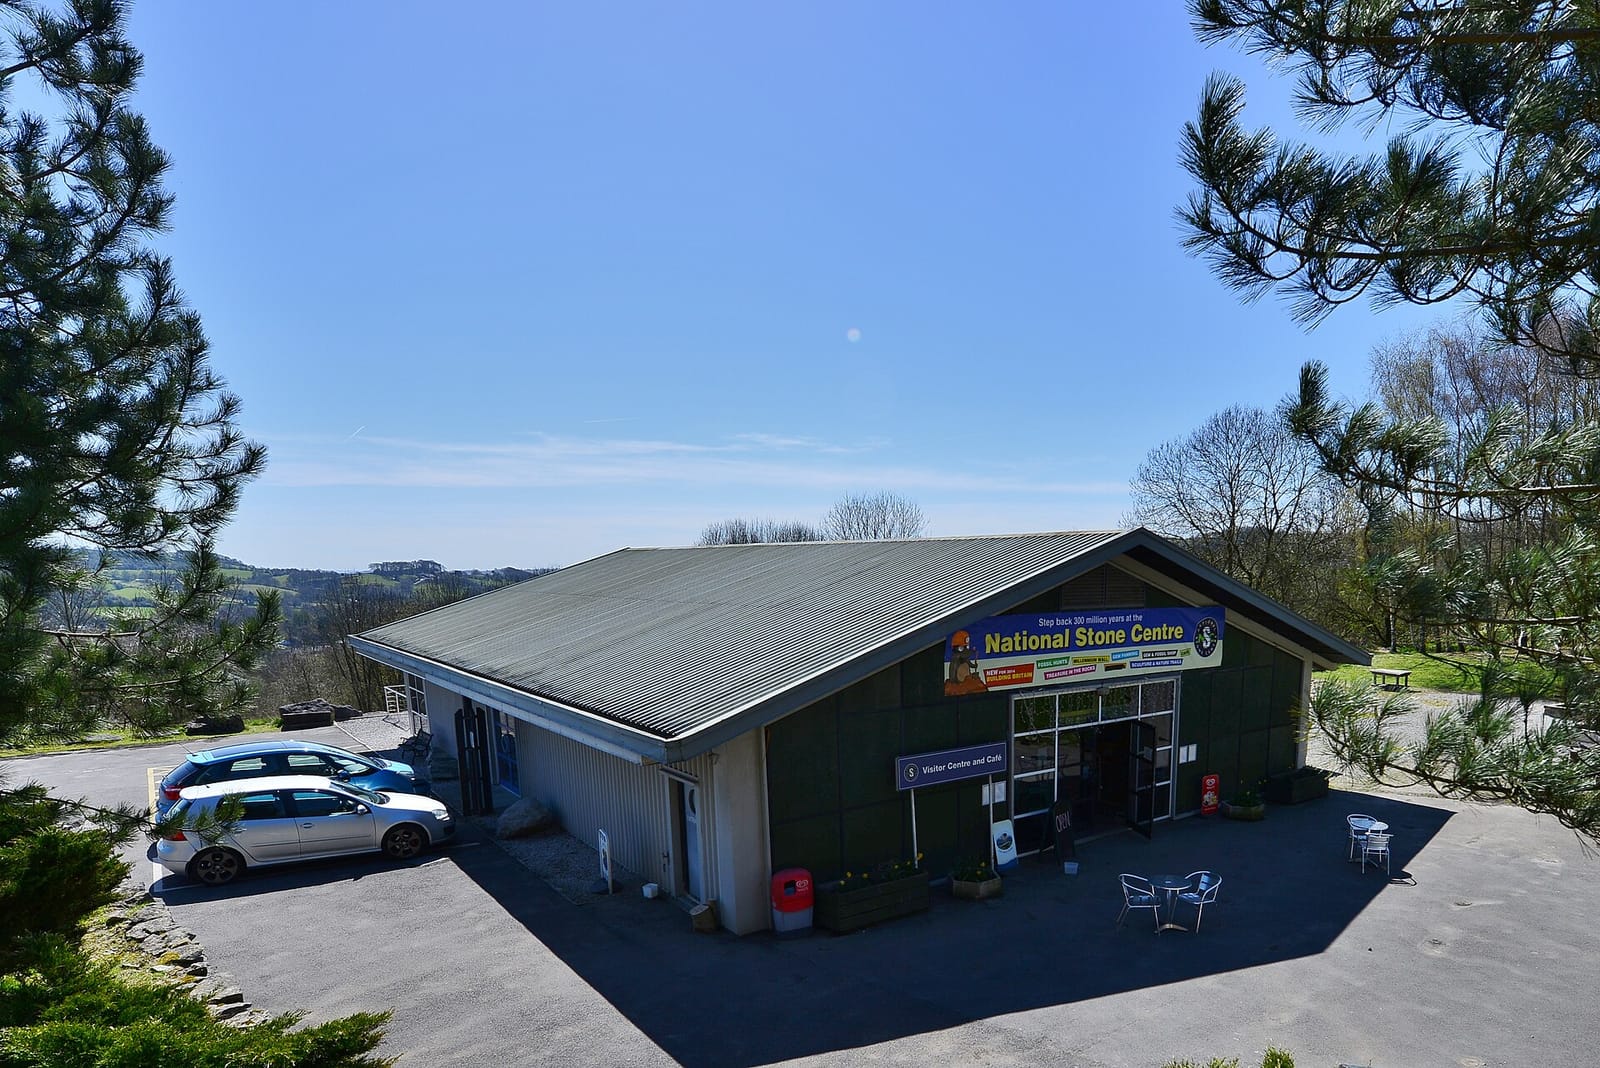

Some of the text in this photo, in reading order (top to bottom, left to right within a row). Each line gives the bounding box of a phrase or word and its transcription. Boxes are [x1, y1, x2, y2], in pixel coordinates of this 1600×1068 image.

[1039, 618, 1054, 628] Step
[1056, 617, 1072, 625] back
[1074, 616, 1085, 625] 300
[1086, 616, 1107, 624] million
[1108, 615, 1124, 624] years
[1126, 614, 1132, 622] at
[985, 624, 1184, 654] National Stone Centre
[987, 672, 1033, 682] BUILDING BRITAIN
[1046, 671, 1068, 679] TREASURE
[1082, 665, 1096, 673] ROCKS
[922, 753, 1002, 775] Visitor Centre and Café
[1055, 811, 1071, 833] OPEN
